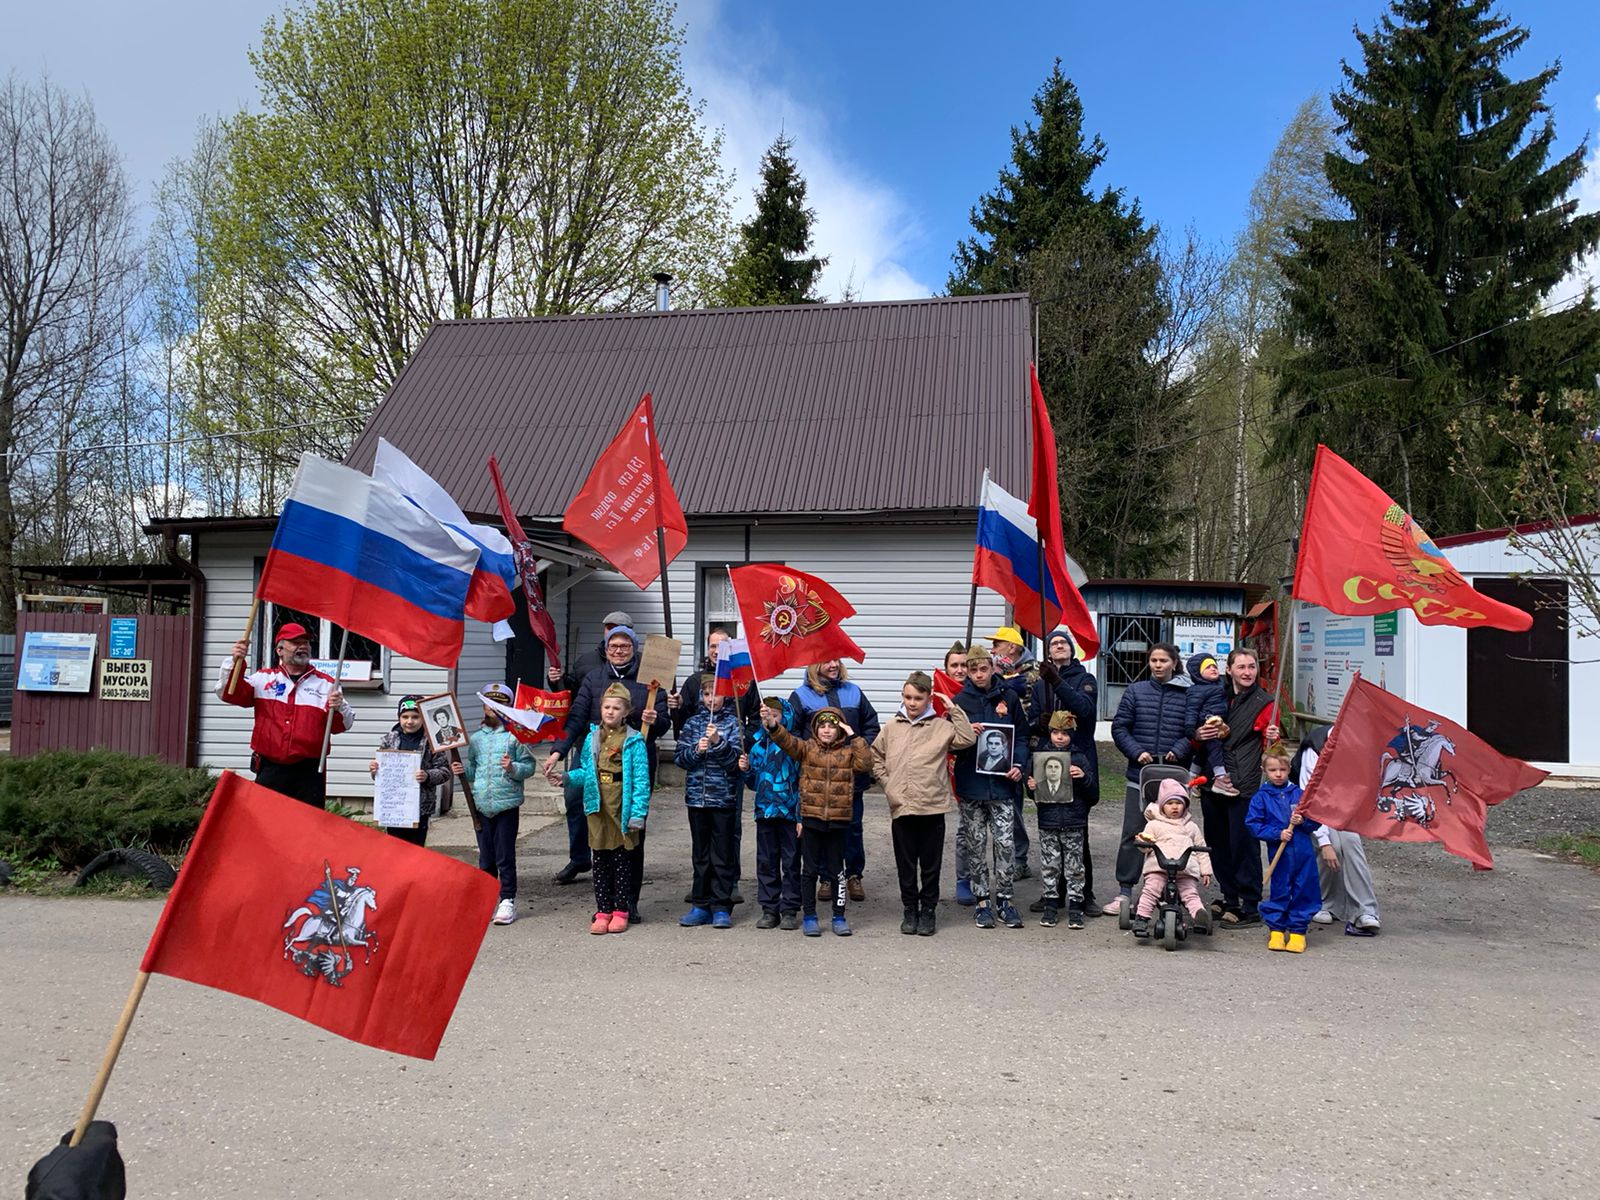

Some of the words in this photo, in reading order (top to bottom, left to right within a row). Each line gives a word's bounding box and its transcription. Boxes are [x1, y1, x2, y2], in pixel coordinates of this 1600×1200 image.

[1342, 575, 1488, 621] СССР
[1176, 617, 1216, 628] АНТЕННЫ
[1215, 618, 1233, 635] TV
[103, 675, 148, 687] МУСОРА
